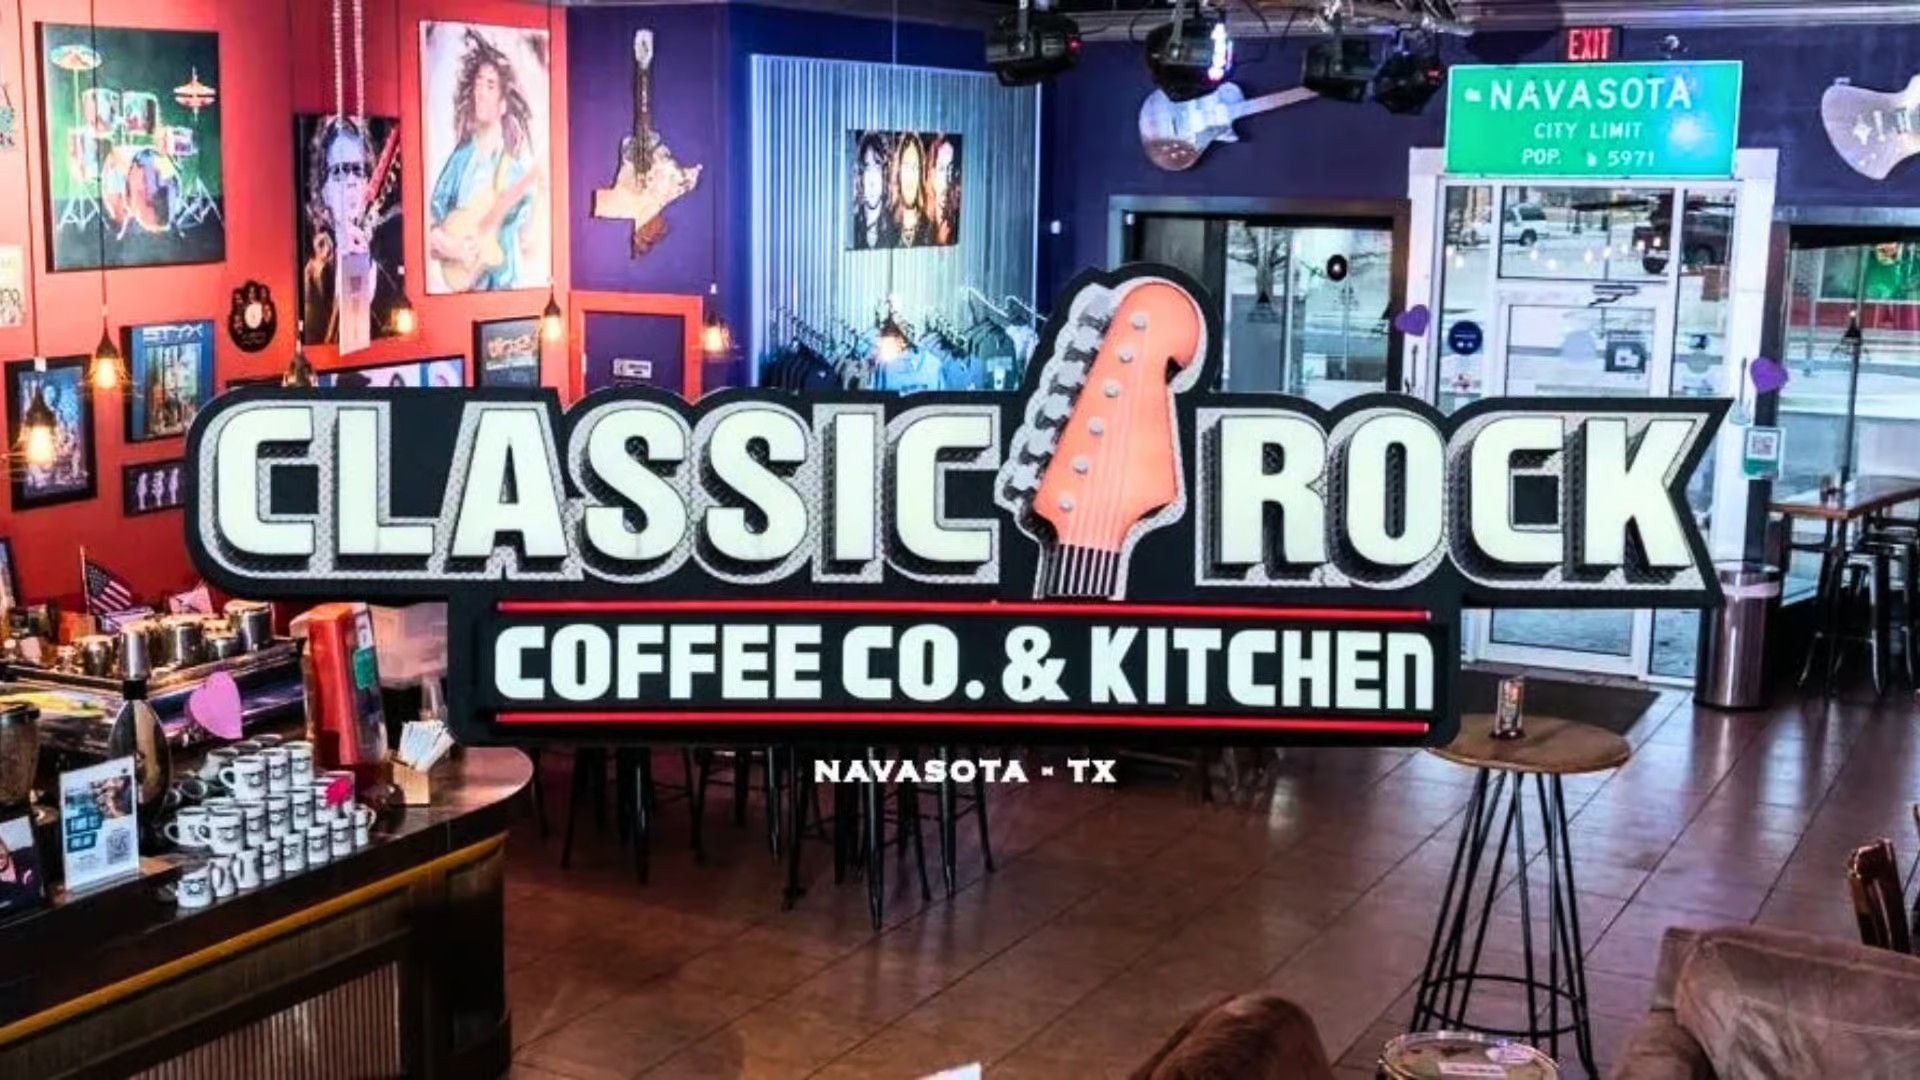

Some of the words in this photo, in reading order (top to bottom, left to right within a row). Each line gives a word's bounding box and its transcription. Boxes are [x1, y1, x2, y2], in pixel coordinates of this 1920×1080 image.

[1568, 28, 1611, 60] EXIT
[1490, 77, 1692, 111] NAVASOTA
[1534, 122, 1577, 139] CITY
[1590, 122, 1642, 139] LIMIT
[1522, 148, 1561, 165] POP.
[1607, 150, 1655, 167] 5971
[143, 324, 203, 341] STYX
